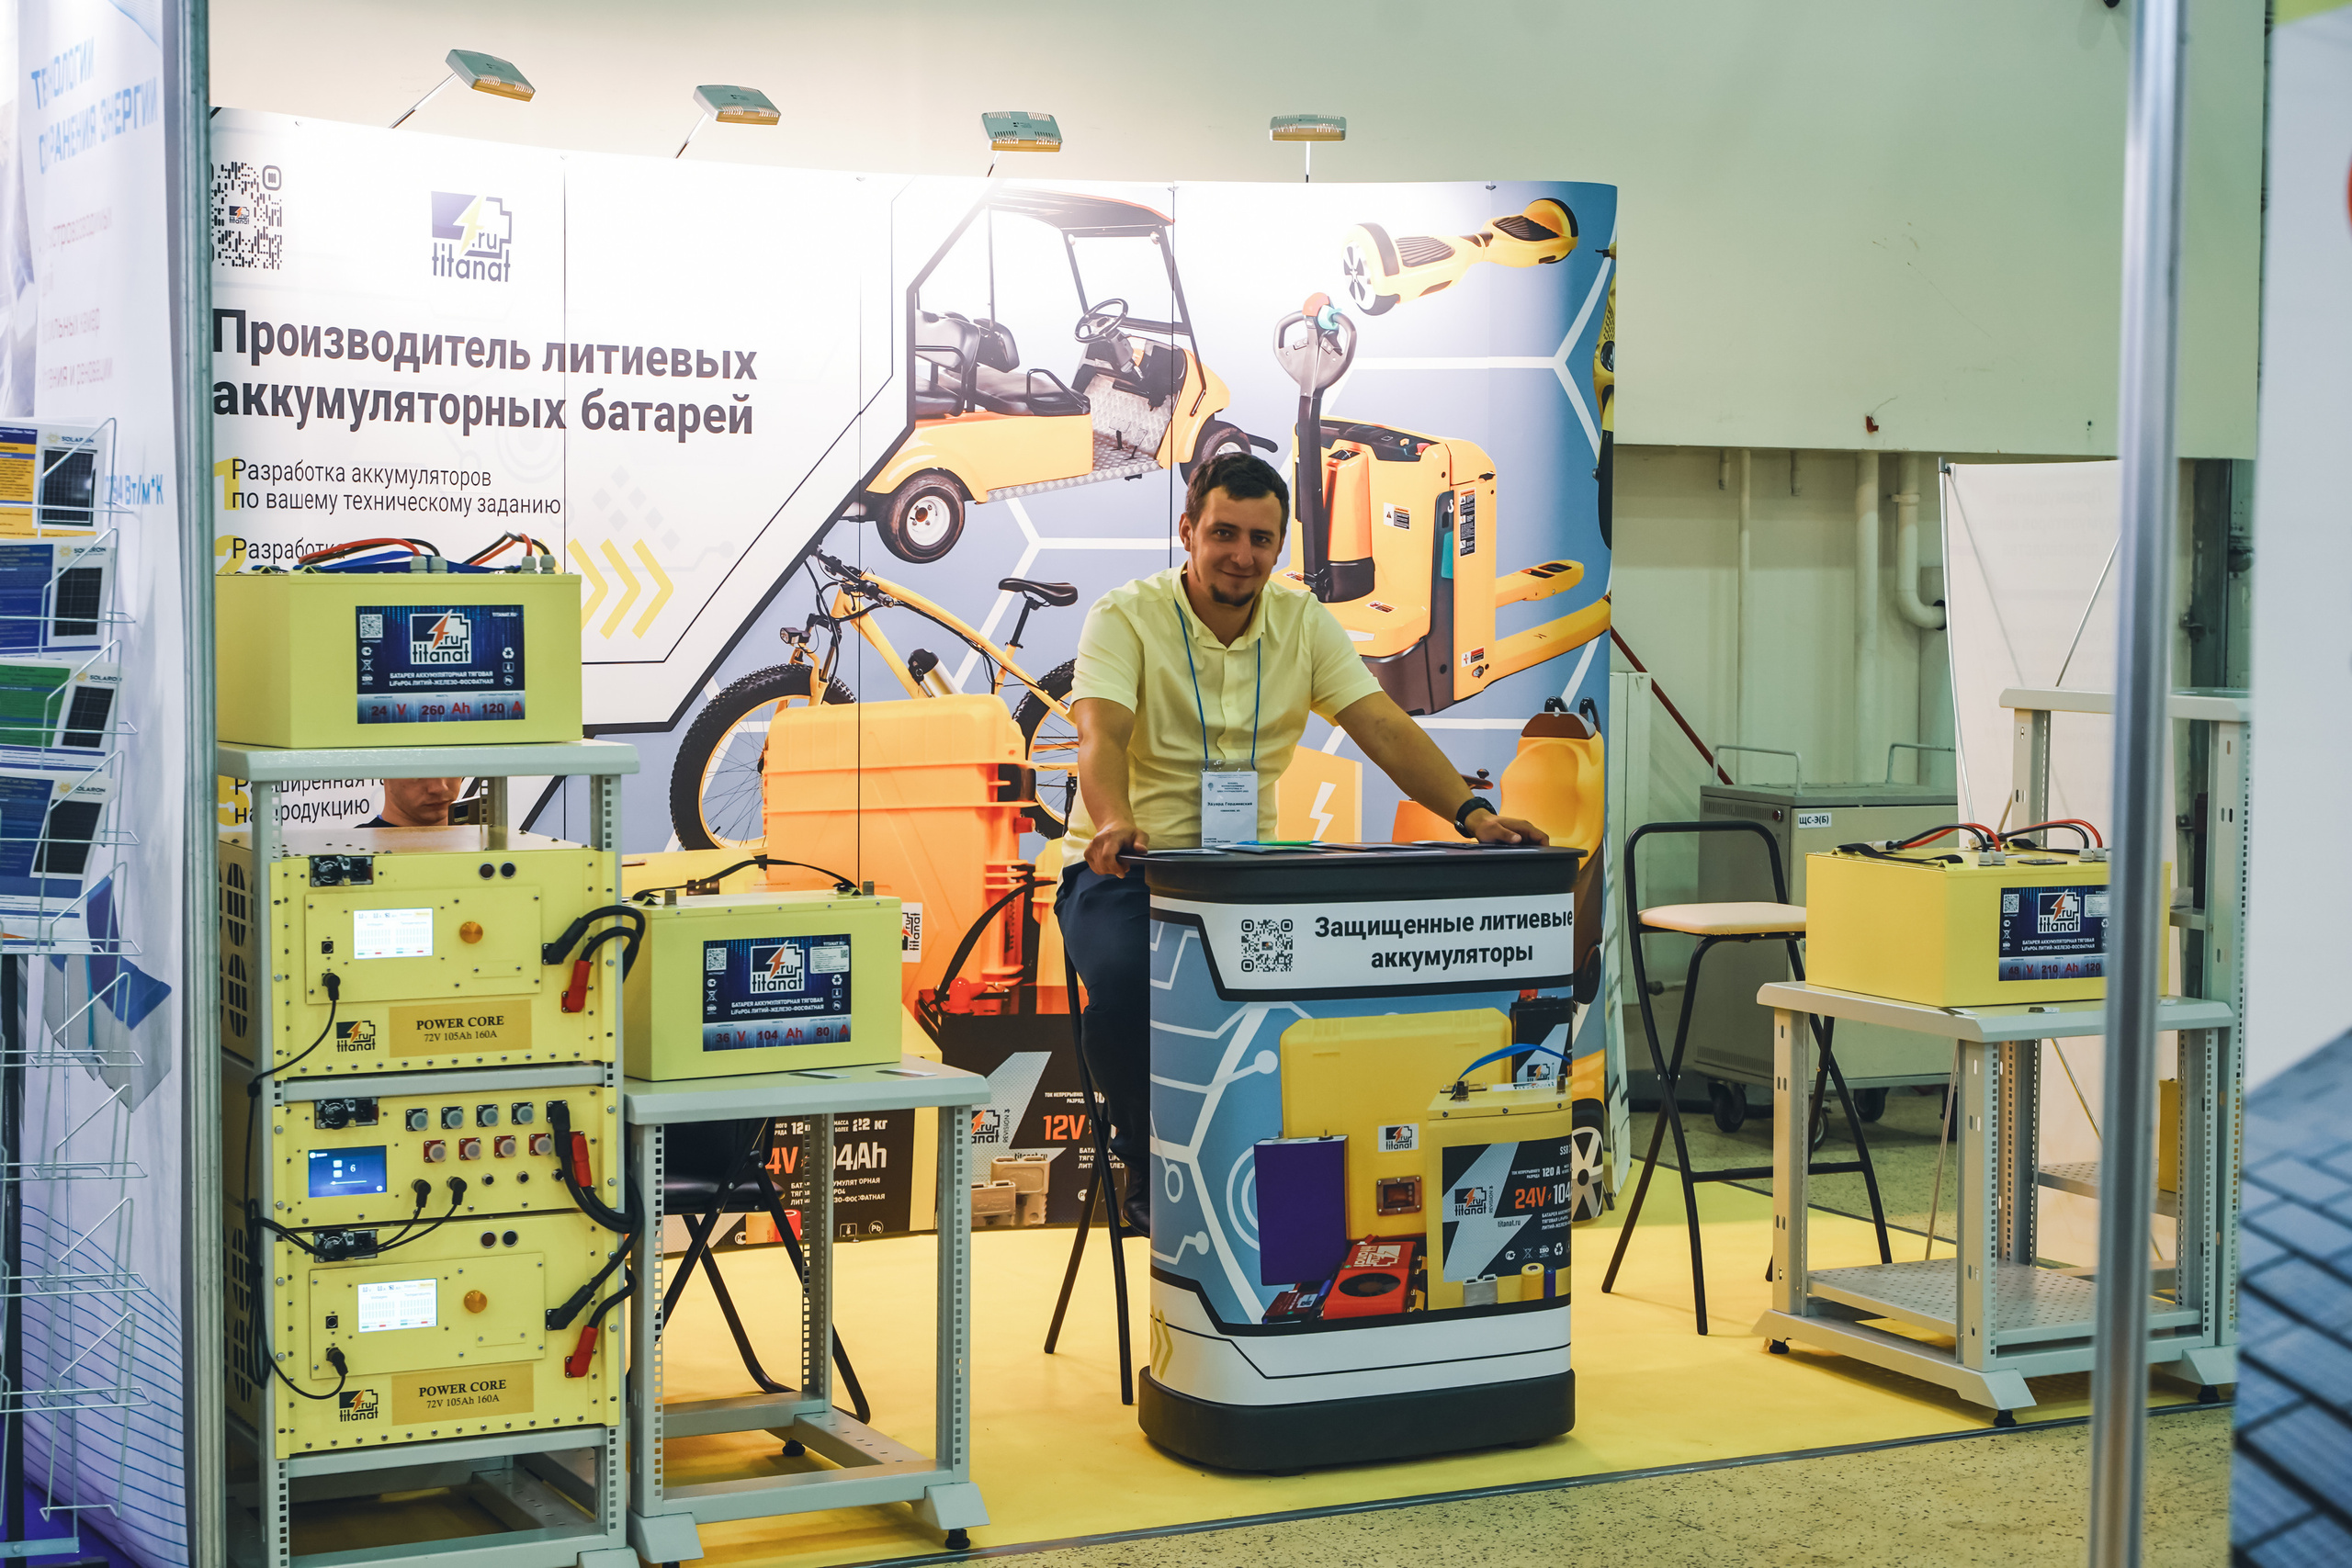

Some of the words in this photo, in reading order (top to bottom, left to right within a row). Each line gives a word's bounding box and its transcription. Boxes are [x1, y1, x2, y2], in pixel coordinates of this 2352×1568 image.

[432, 243, 511, 282] titanat
[213, 309, 531, 373] Производитель
[542, 343, 758, 380] литиевых
[213, 381, 568, 436] аккумуляторных
[582, 388, 752, 443] батарей
[232, 458, 345, 486] Разработка
[352, 467, 492, 491] аккумуляторов
[232, 492, 259, 509] по
[266, 493, 338, 515] вашему
[344, 494, 473, 518] техническому
[477, 498, 561, 517] заданию
[413, 643, 469, 662] titanat
[371, 705, 387, 716] 24
[396, 704, 407, 715] V
[422, 705, 446, 716] 260
[451, 703, 470, 714] Ah
[481, 704, 505, 714] 120
[512, 701, 523, 712] A
[1799, 815, 1829, 826] ЩС-Э(Б)
[1315, 916, 1475, 941] Защищенные
[1479, 910, 1573, 931] литиевые
[2039, 916, 2080, 932] titanat
[1371, 945, 1533, 973] аккумуляторы
[2008, 966, 2019, 975] 48
[2026, 964, 2034, 974] V
[2041, 964, 2058, 974] 210
[2065, 963, 2079, 973] Ah
[2086, 963, 2101, 972] 120
[752, 972, 803, 992] titanat
[416, 1018, 465, 1031] POWER
[468, 1015, 504, 1027] CORE
[424, 1033, 441, 1043] 72V
[444, 1032, 472, 1042] 105Ah
[475, 1030, 498, 1039] 160A
[717, 1033, 729, 1043] 36
[737, 1031, 746, 1042] V
[757, 1030, 778, 1040] 104
[786, 1028, 803, 1039] Ah
[816, 1027, 830, 1036] 80
[839, 1024, 849, 1034] A
[336, 1038, 376, 1053] titanat
[1043, 1114, 1086, 1140] 12V
[971, 1130, 1000, 1145] anat
[1385, 1139, 1413, 1150] titanat
[765, 1146, 798, 1175] 4V
[832, 1142, 888, 1170] 4Ah
[350, 1164, 356, 1173] 6
[1542, 1167, 1555, 1178] 120
[1515, 1186, 1547, 1210] 24V
[1454, 1202, 1487, 1216] titanat
[1498, 1219, 1521, 1227] titanat.ru
[419, 1382, 468, 1397] POWER
[469, 1379, 507, 1392] CORE
[426, 1399, 444, 1409] 72V
[447, 1396, 475, 1407] 105Ah
[477, 1393, 500, 1404] 160A
[339, 1406, 379, 1422] titanat
